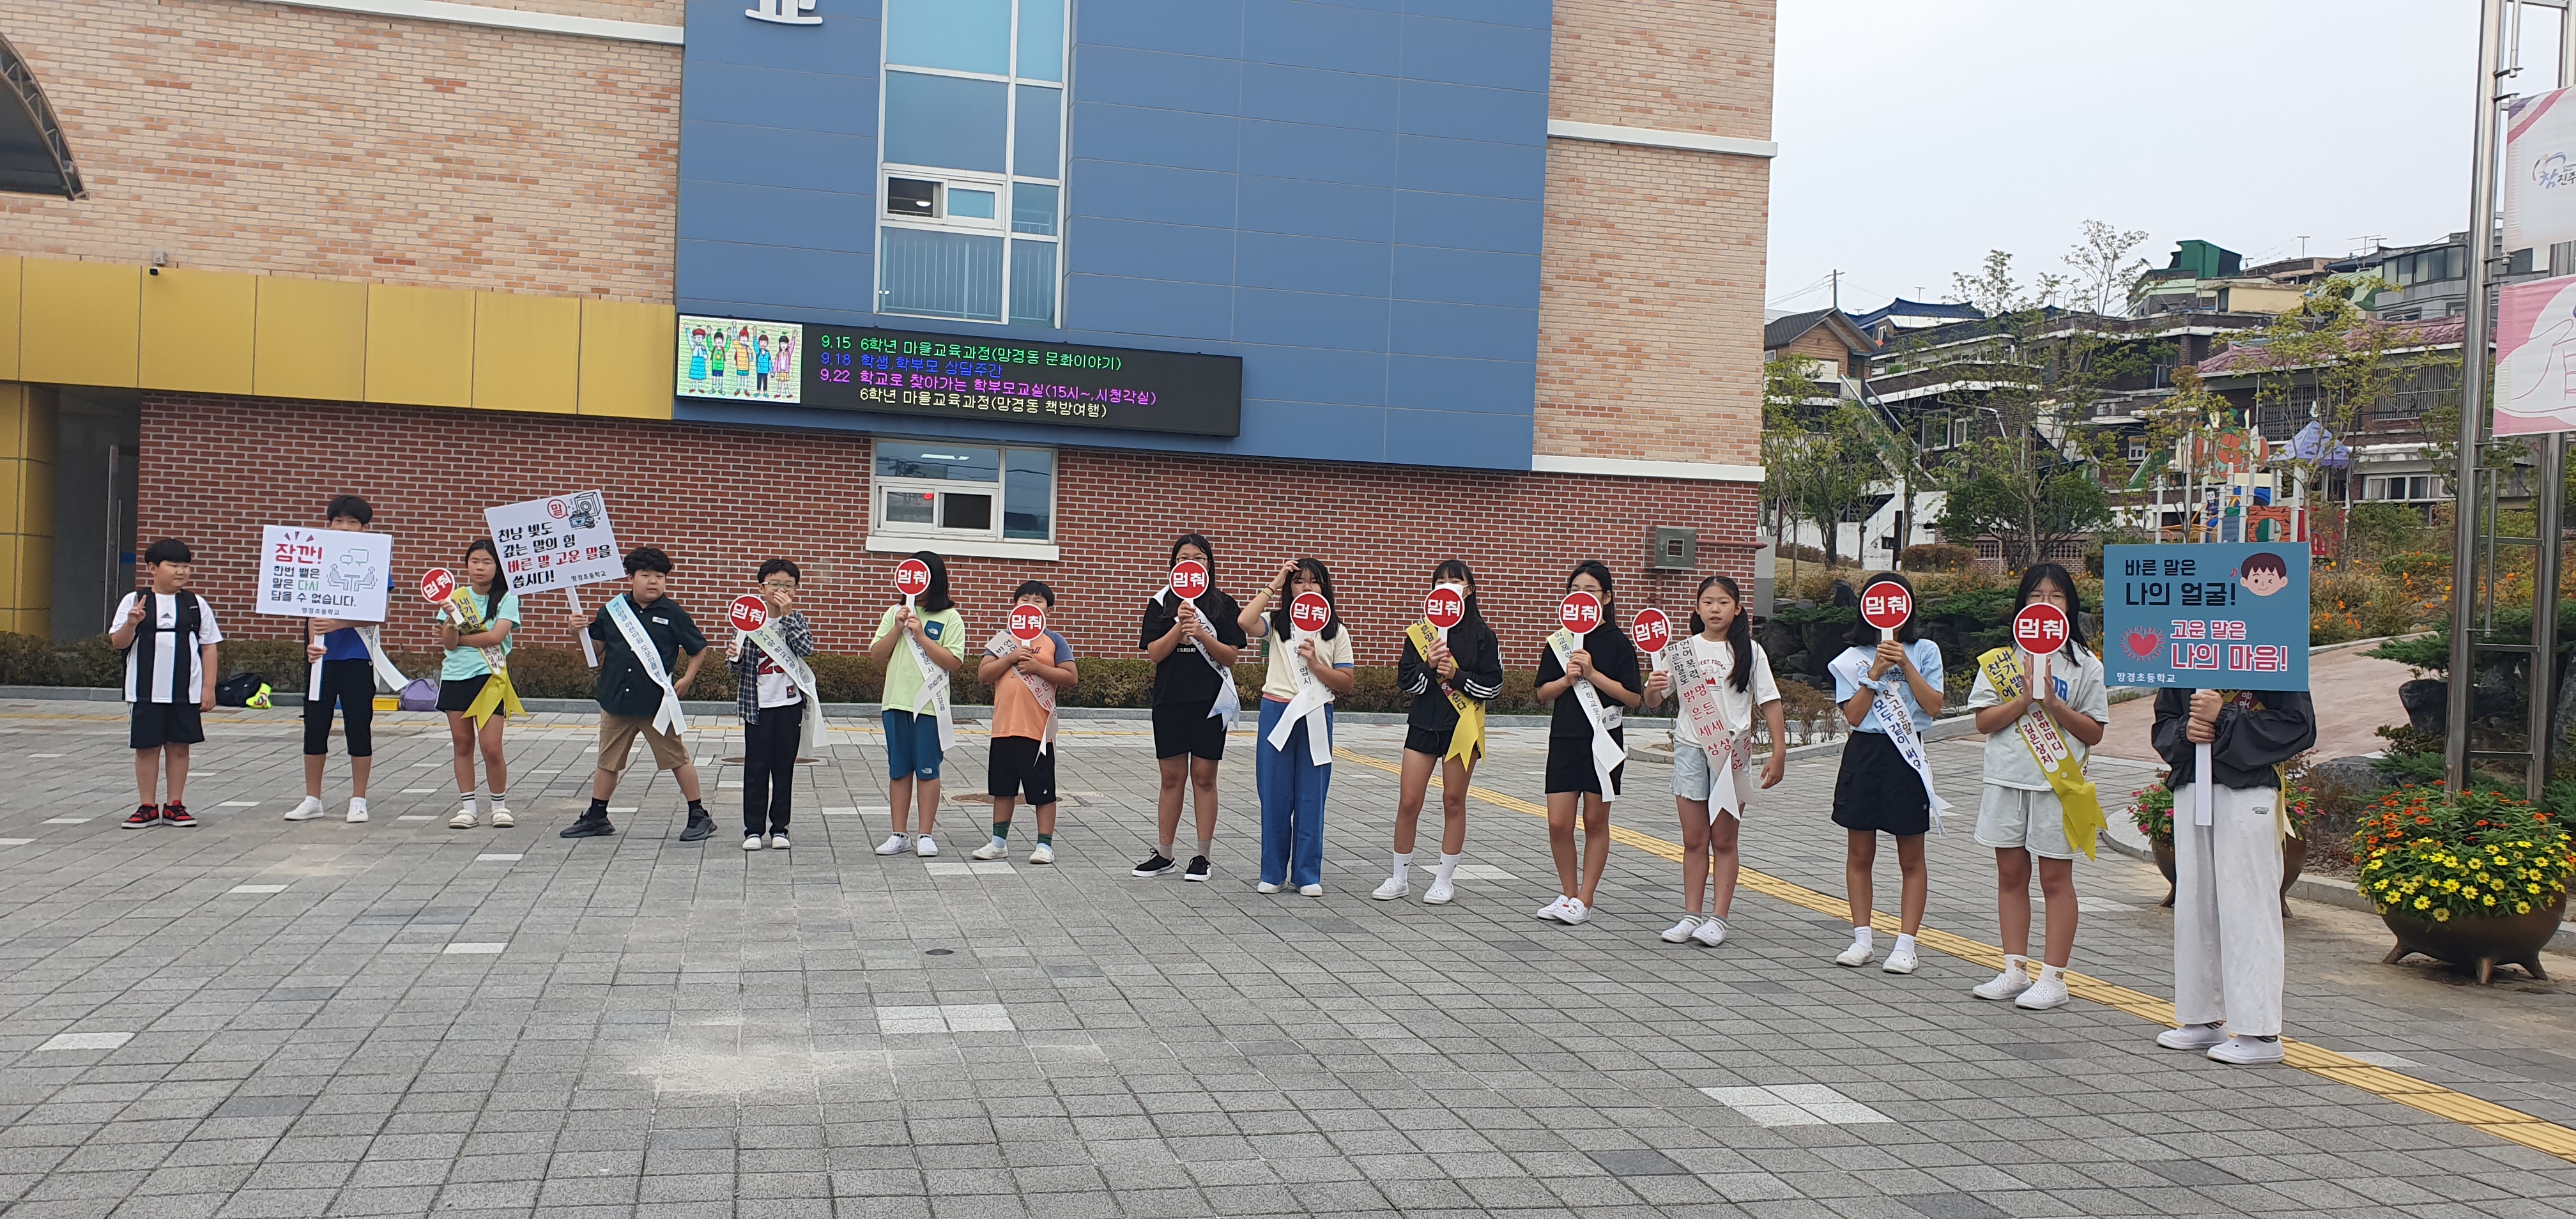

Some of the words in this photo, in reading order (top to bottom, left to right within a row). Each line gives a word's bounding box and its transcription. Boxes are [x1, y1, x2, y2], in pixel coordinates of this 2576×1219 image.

[820, 334, 852, 349] 9.15
[860, 337, 897, 354] 6학년
[903, 340, 1040, 365] 마을교육과정(망경동
[1045, 351, 1122, 371] 문화이야기)
[820, 351, 852, 366] 9.18
[860, 353, 939, 374] 학생,학부모
[944, 359, 1003, 379] 상담주간
[820, 367, 850, 383] 9.22
[859, 369, 903, 387] 학교로
[910, 372, 967, 392] 찾아가는
[859, 387, 897, 404] 6학년
[903, 390, 1040, 414] 마을교육과정(망경동
[1045, 399, 1108, 418] 책방여행)
[551, 503, 563, 516] 말
[498, 526, 523, 543] 천냥
[528, 521, 554, 538] 빚도
[275, 543, 323, 565] 잠깐!
[503, 543, 528, 558] 갚는
[533, 537, 558, 554] 말의
[562, 533, 576, 548] 힘
[507, 557, 533, 573] 바른
[537, 554, 551, 569] 말
[555, 549, 581, 565] 고운
[586, 544, 612, 561] 말을
[2125, 558, 2158, 576] 바른
[2163, 558, 2196, 576] 말은
[273, 565, 295, 577] 한번
[299, 567, 321, 579] 뱉은
[512, 569, 555, 589] 씁시다!
[898, 569, 927, 585] 멈춰
[1173, 572, 1206, 588] 멈춰
[272, 578, 294, 590] 말은
[297, 579, 319, 592] 다시
[423, 572, 452, 599] 멈춰
[2125, 581, 2170, 606] 나의
[2181, 581, 2236, 606] 얼굴!
[271, 590, 293, 602] 담을
[296, 592, 307, 603] 수
[311, 593, 357, 608] 없습니다.
[1427, 599, 1461, 617] 멈춰
[1866, 595, 1907, 615] 멈춰
[732, 602, 765, 625] 멈춰
[1011, 615, 1042, 630] 멈춰
[1293, 602, 1328, 623] 멈춰
[1562, 603, 1598, 622] 멈춰
[1634, 618, 1668, 641] 멈춰
[2017, 618, 2064, 640] 멈춰
[2170, 619, 2206, 640] 고운
[2210, 619, 2247, 641] 말은
[1680, 640, 1693, 657] 언어
[2170, 643, 2220, 670] 나의
[2228, 644, 2288, 671] 마음!
[1685, 659, 1701, 680] 폭력
[2116, 672, 2176, 684] 망경초등학교
[1874, 699, 1894, 722] 모두
[1889, 722, 1910, 745] 같이
